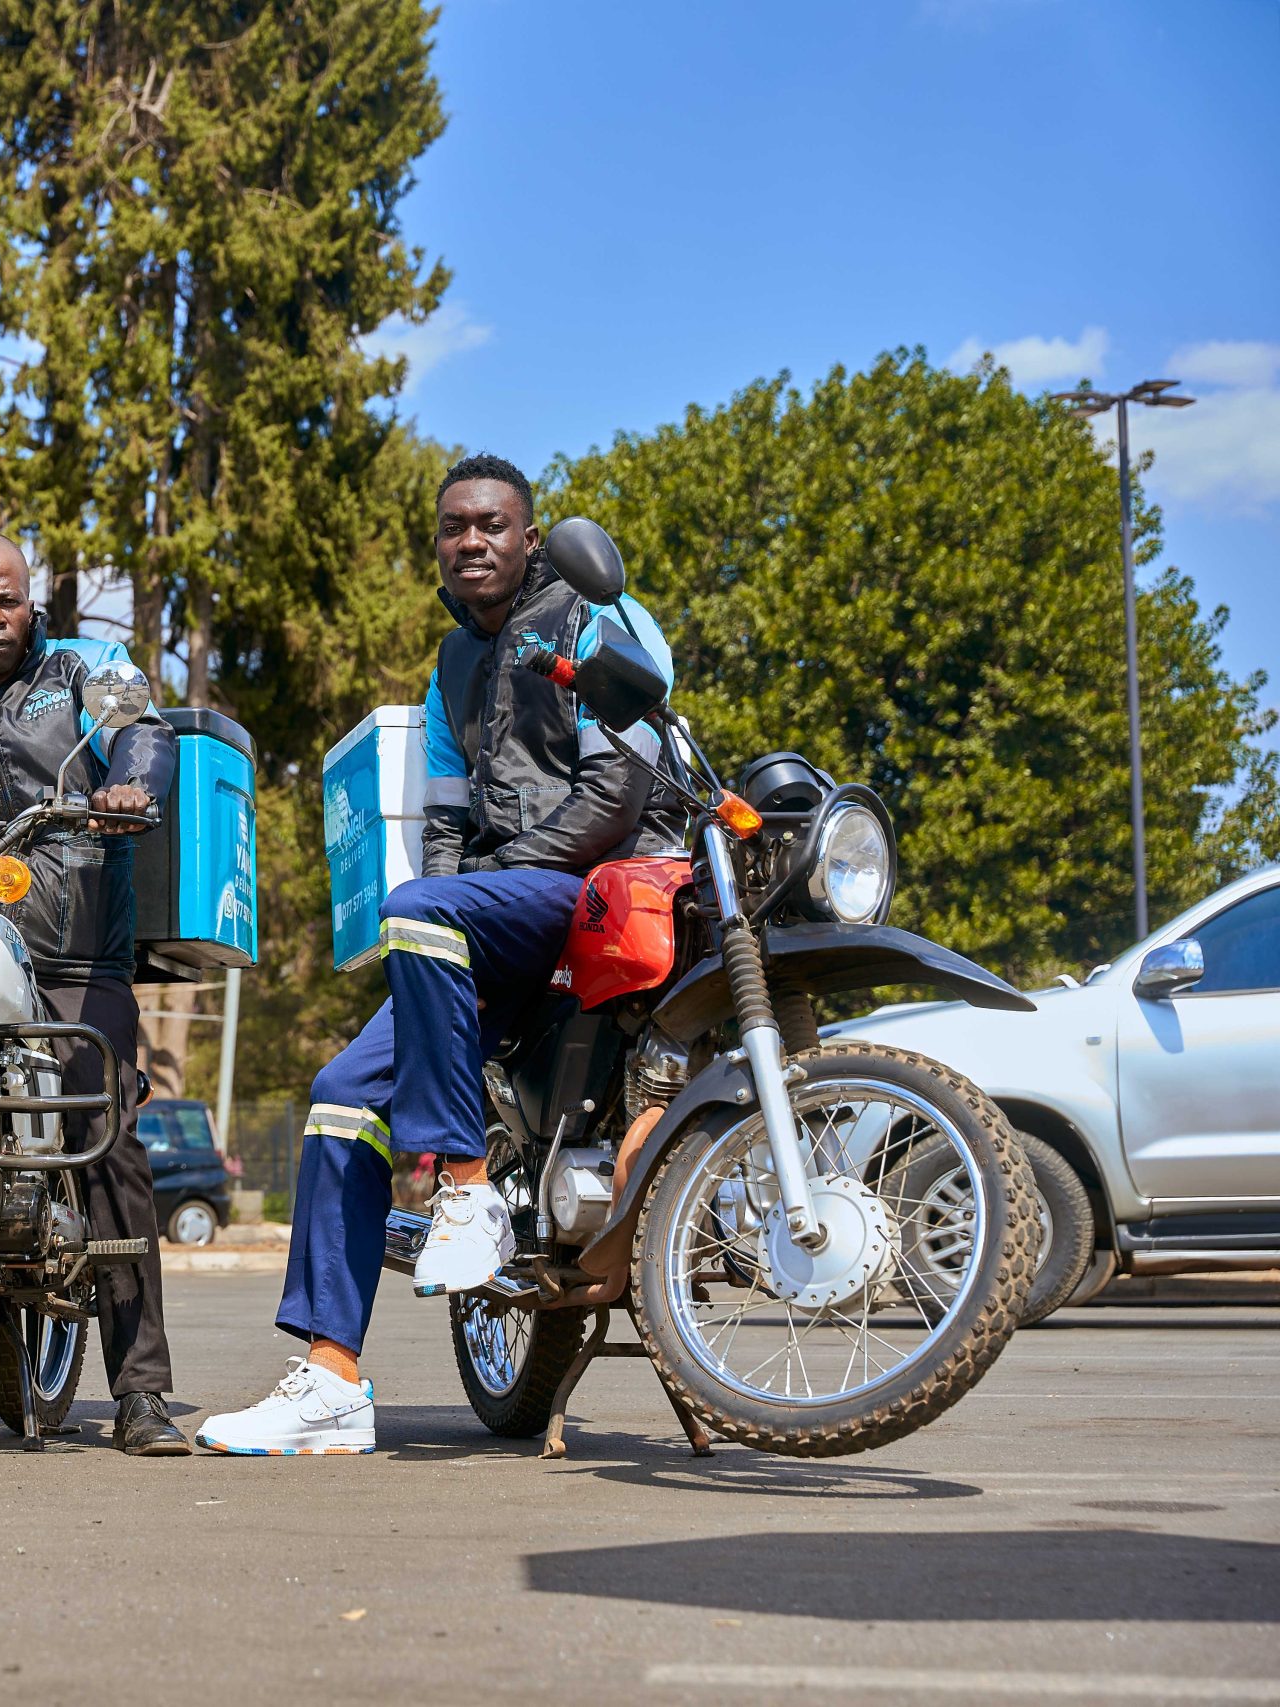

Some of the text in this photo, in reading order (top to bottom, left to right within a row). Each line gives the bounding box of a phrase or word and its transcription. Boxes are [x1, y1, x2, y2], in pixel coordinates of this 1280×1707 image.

[24, 688, 70, 714] YANGU
[236, 843, 252, 880] YAN
[340, 838, 369, 875] DELIVERY
[342, 879, 378, 921] 077 577 3949
[579, 921, 606, 933] HONDA
